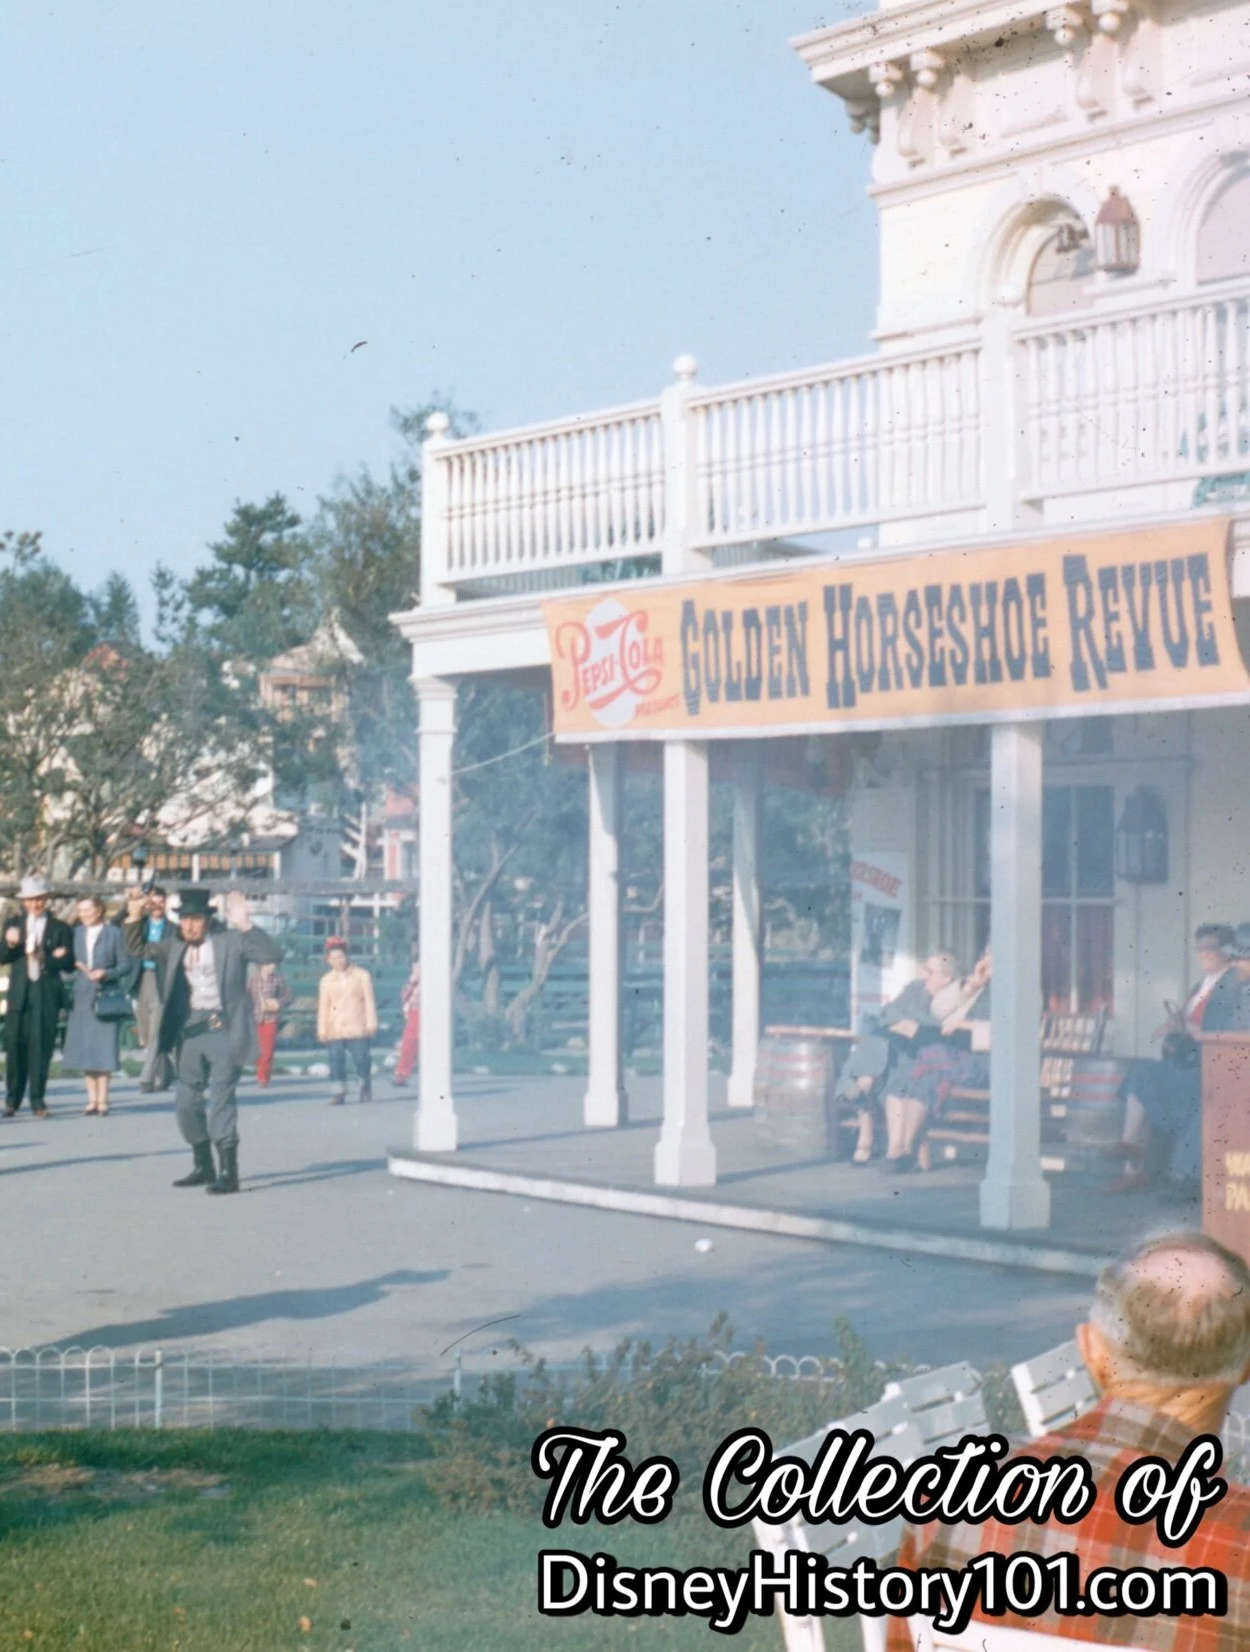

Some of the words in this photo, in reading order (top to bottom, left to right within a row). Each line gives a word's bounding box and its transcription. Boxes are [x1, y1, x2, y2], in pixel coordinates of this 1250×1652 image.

[680, 599, 811, 717] GOLDEN
[823, 572, 1051, 709] HORSESHOE
[1062, 553, 1221, 692] REVUE
